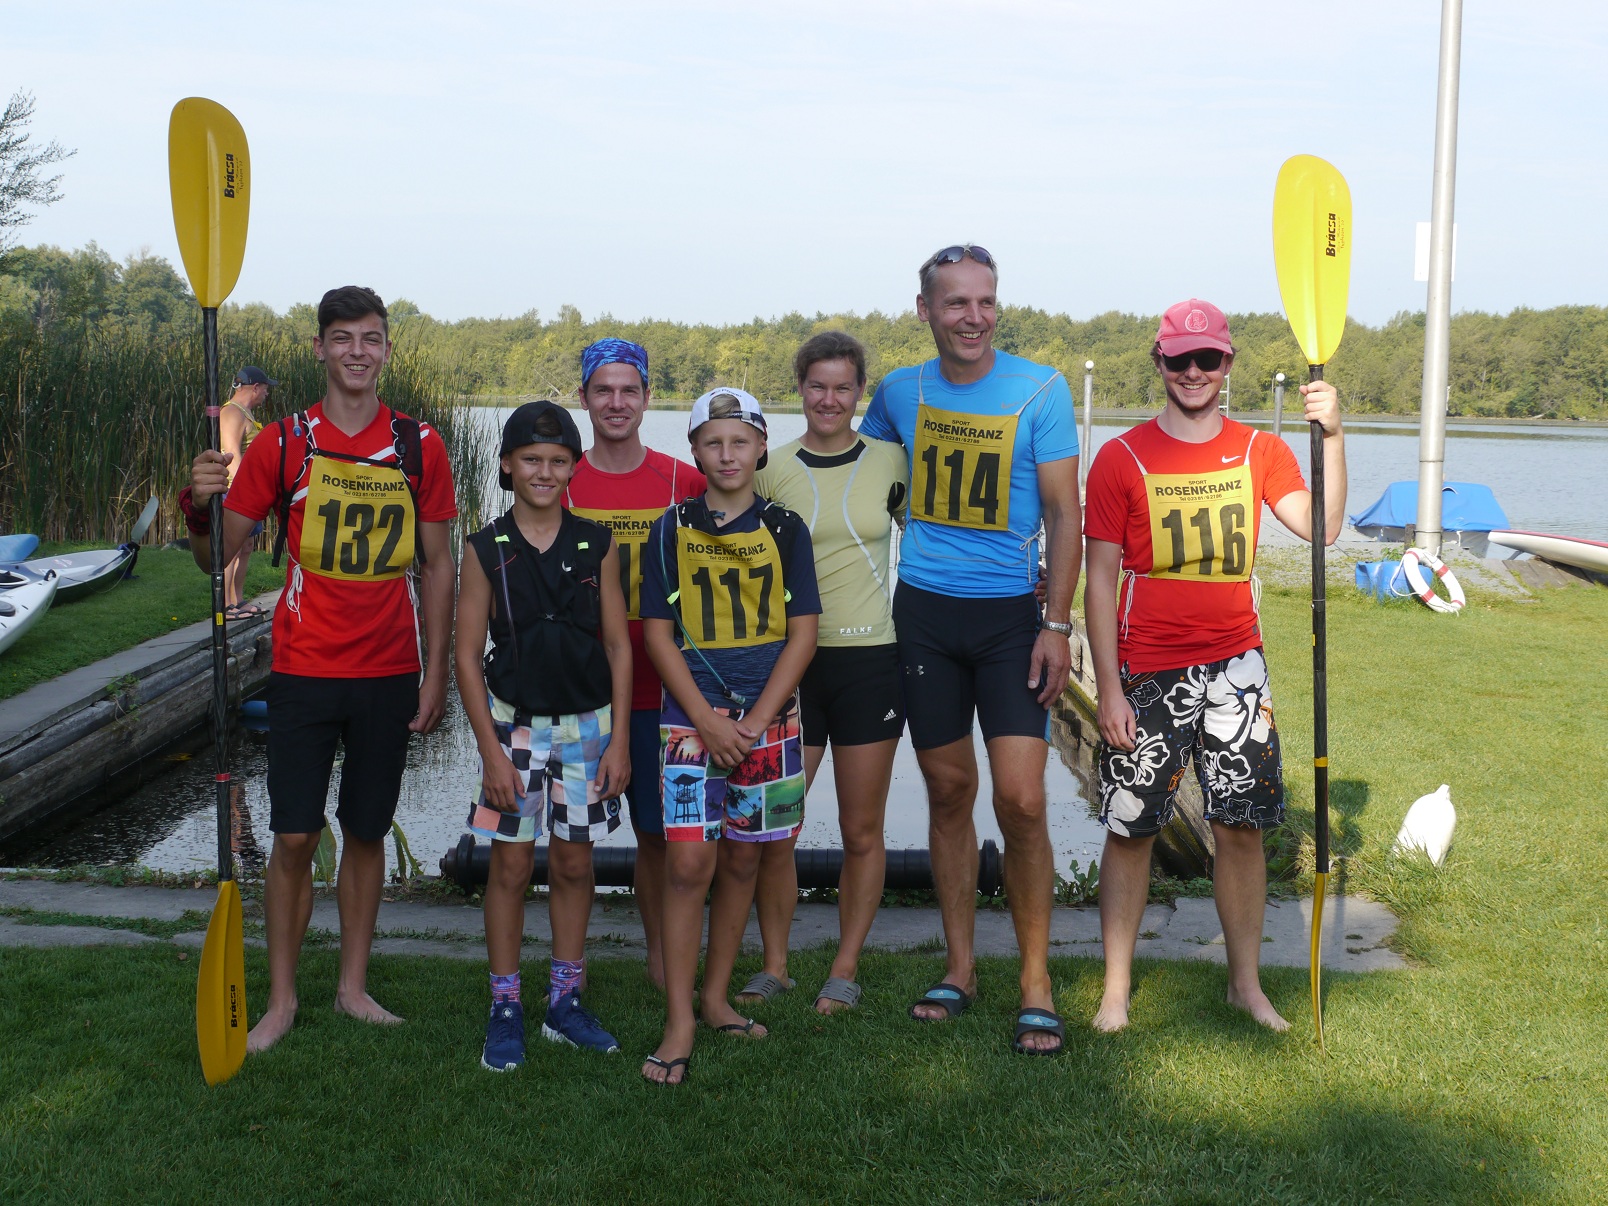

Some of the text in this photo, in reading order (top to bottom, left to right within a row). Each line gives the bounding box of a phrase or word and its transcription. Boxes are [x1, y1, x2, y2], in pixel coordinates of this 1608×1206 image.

[224, 153, 234, 198] Brácsa
[1326, 213, 1336, 257] Brácsa
[924, 419, 1003, 440] ROSENKRANZ
[322, 474, 405, 491] ROSENKRANZ
[922, 444, 1000, 525] 114
[1155, 480, 1242, 497] ROSENKRANZ
[318, 499, 405, 575] 132
[687, 542, 767, 557] ROSENKRANZ
[1161, 503, 1246, 575] 116
[692, 562, 773, 641] 117
[840, 626, 872, 635] FALKE
[230, 984, 238, 1028] Brácsa
